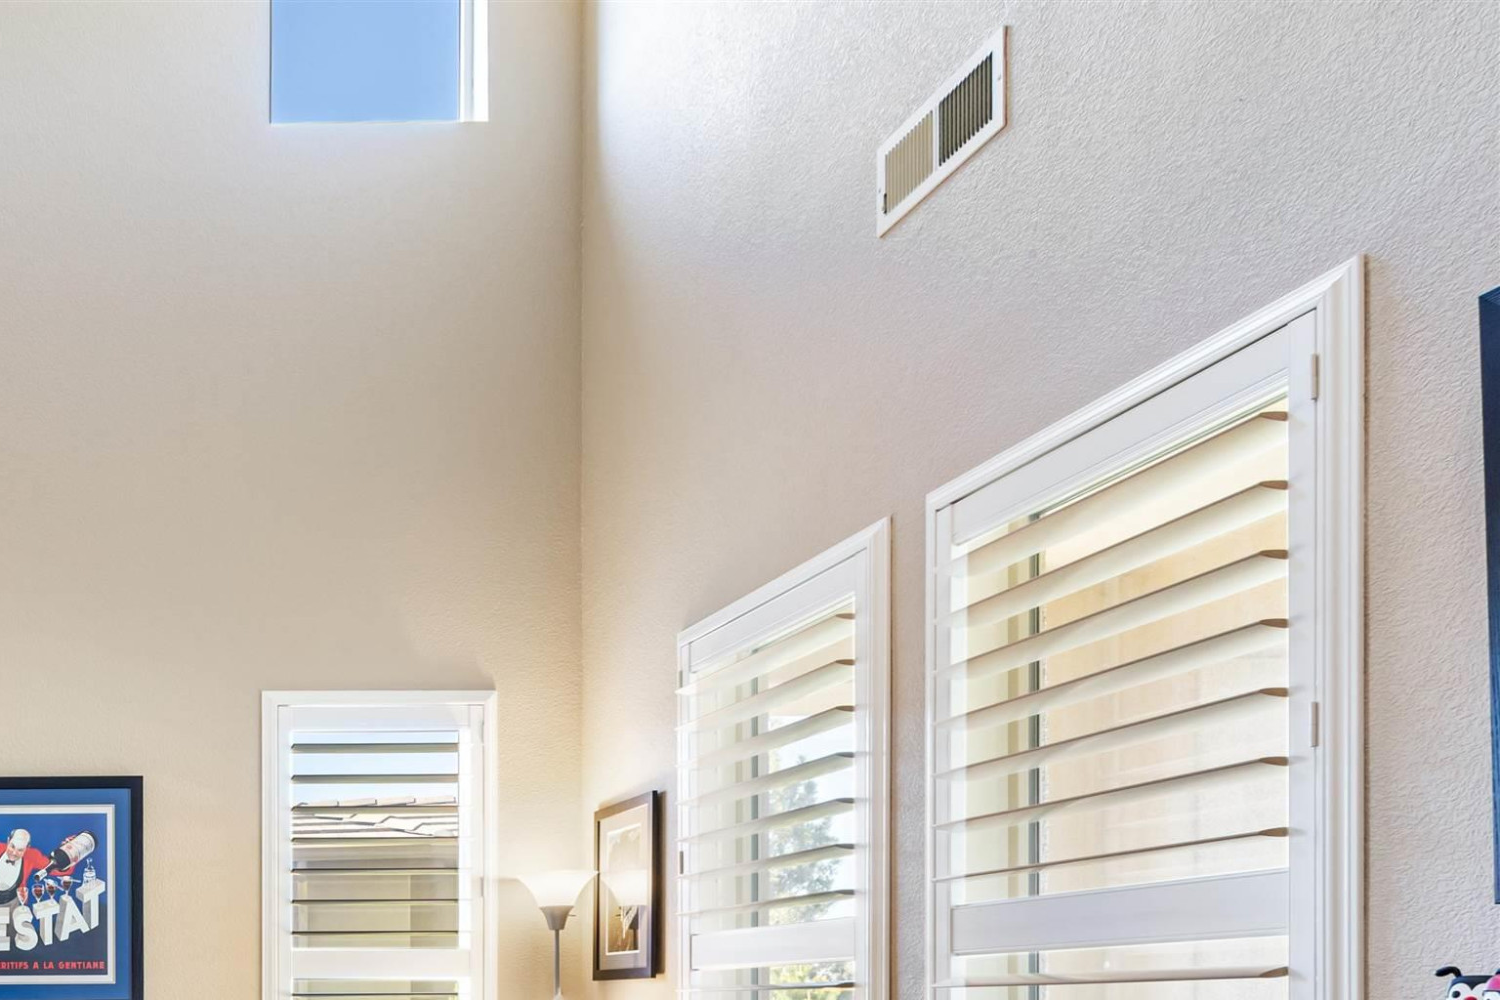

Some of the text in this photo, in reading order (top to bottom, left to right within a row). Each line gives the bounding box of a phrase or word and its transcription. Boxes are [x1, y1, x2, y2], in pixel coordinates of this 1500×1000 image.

[33, 962, 39, 970] A
[43, 962, 55, 970] LA
[58, 961, 105, 970] GENTIANE
